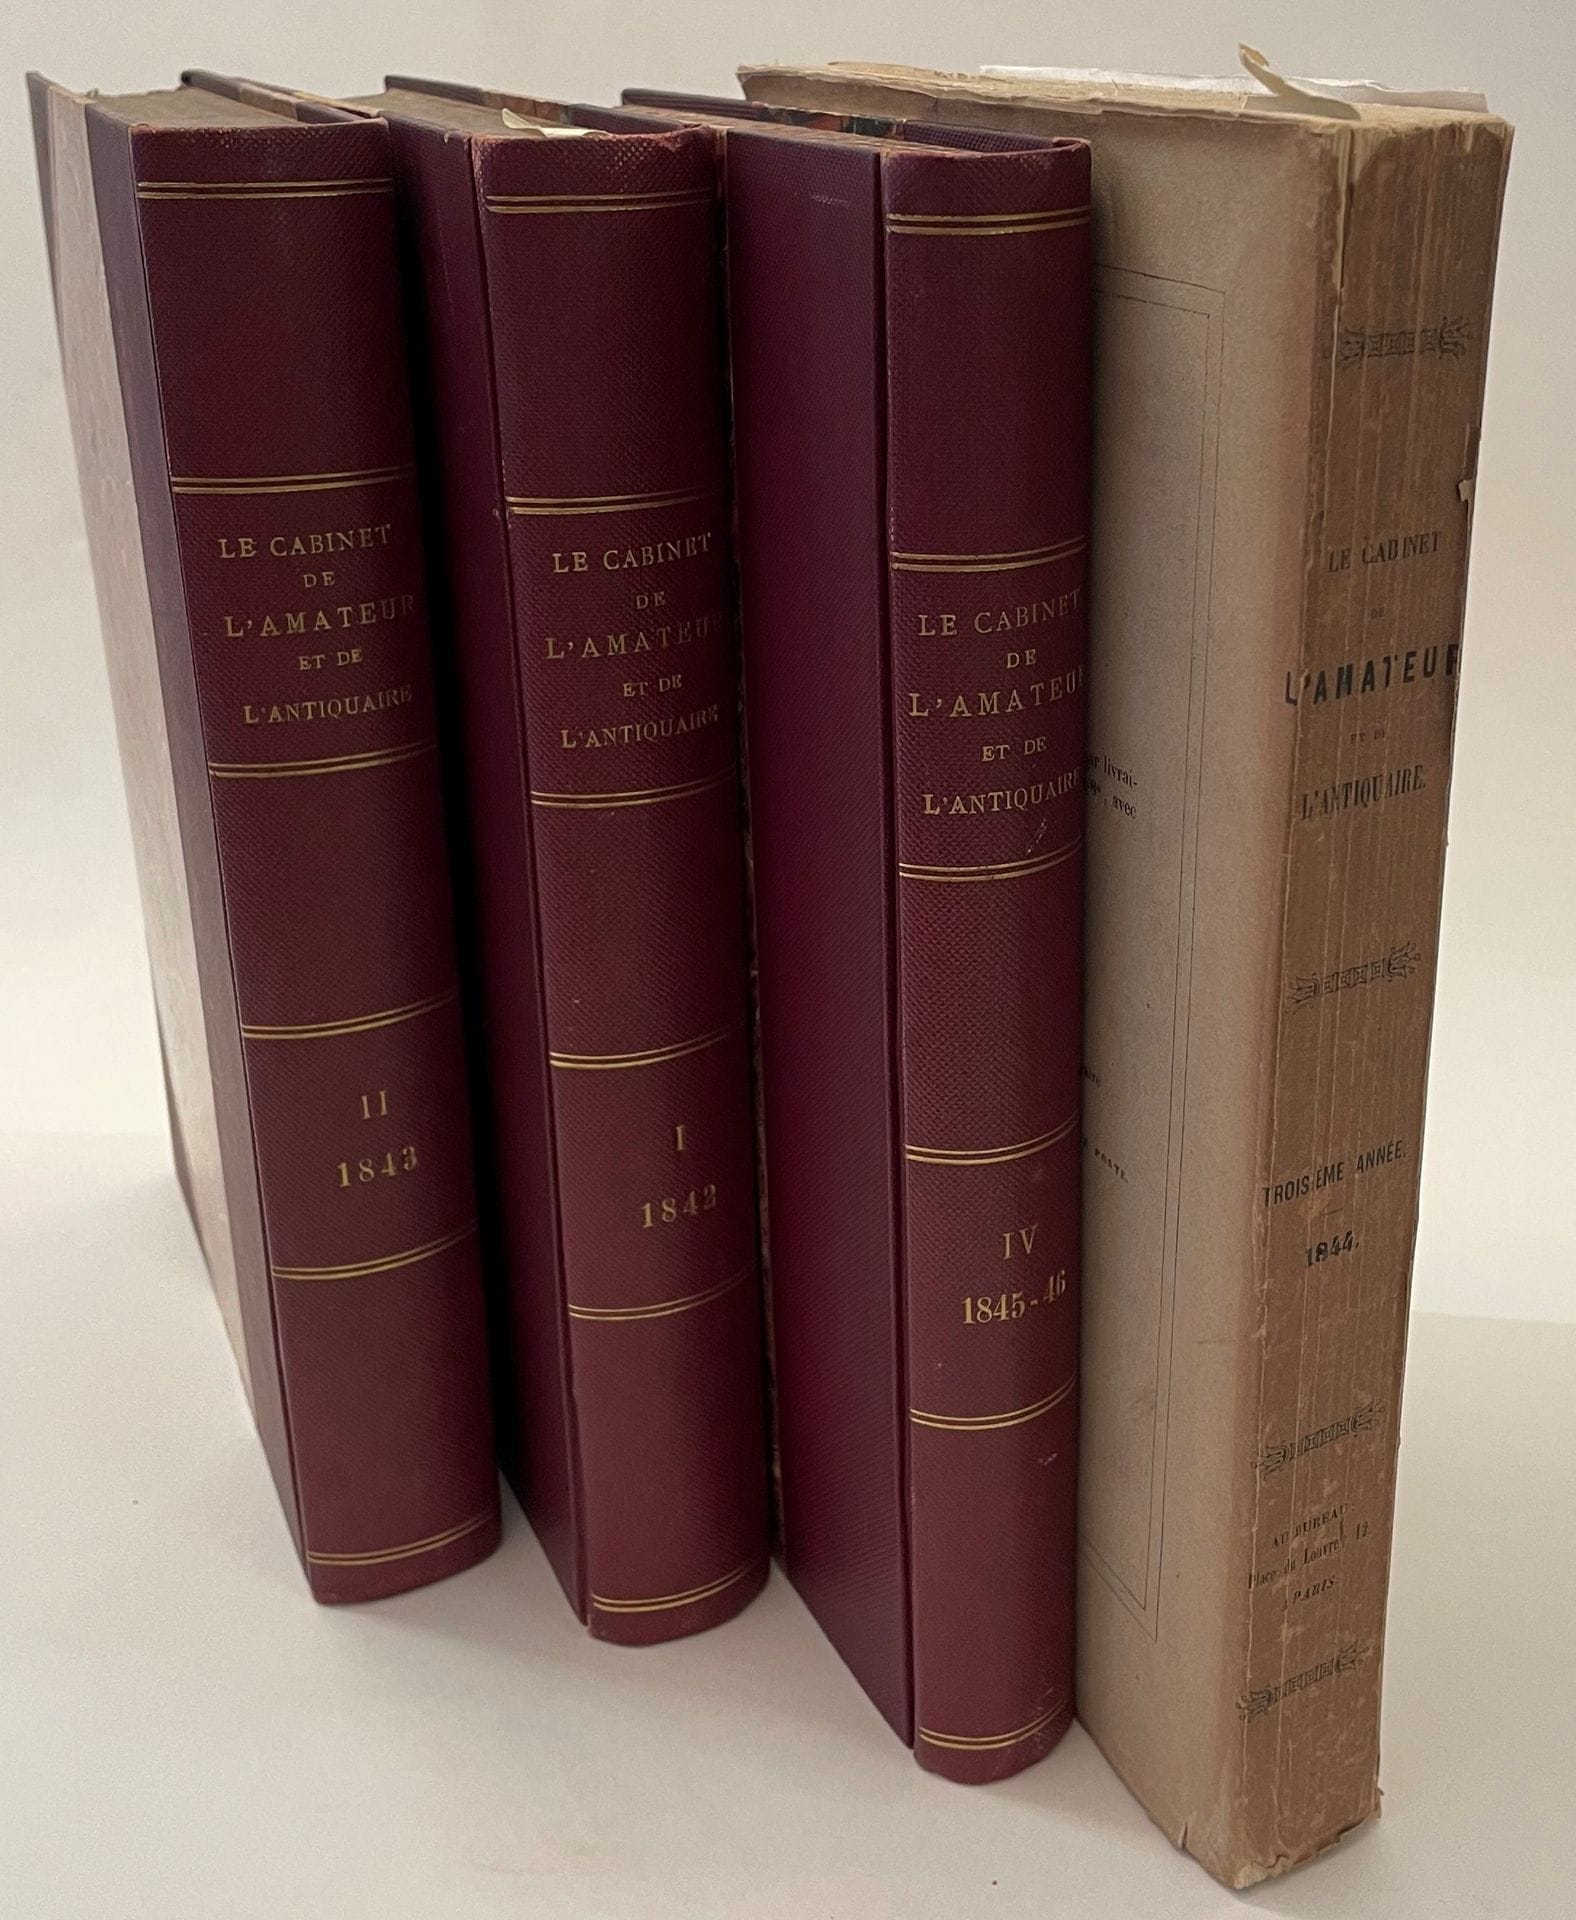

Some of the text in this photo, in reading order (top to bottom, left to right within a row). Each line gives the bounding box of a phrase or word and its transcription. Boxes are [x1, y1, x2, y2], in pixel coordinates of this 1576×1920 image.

[218, 524, 391, 559] LE CABINET
[552, 532, 712, 573] LE CABINET
[1328, 548, 1351, 573] LE
[303, 571, 336, 588] DE
[224, 595, 414, 637] L'AMATEUR
[636, 591, 665, 610] DE
[918, 588, 1081, 636] LE CABINET
[299, 649, 363, 671] ET DE
[1006, 649, 1036, 669] DE
[623, 674, 682, 697] ET DE
[243, 684, 412, 724] L'ANTIQUAIRE
[560, 704, 718, 749] L'ANTIQUAIRE
[982, 736, 1047, 762] ET DE
[923, 767, 1081, 815] L'ANTIQUAIRE
[1112, 796, 1138, 820] avec
[361, 1090, 388, 1119] II
[337, 1146, 417, 1188] 1843
[641, 1184, 716, 1229] 1842
[1002, 1223, 1038, 1260] IV
